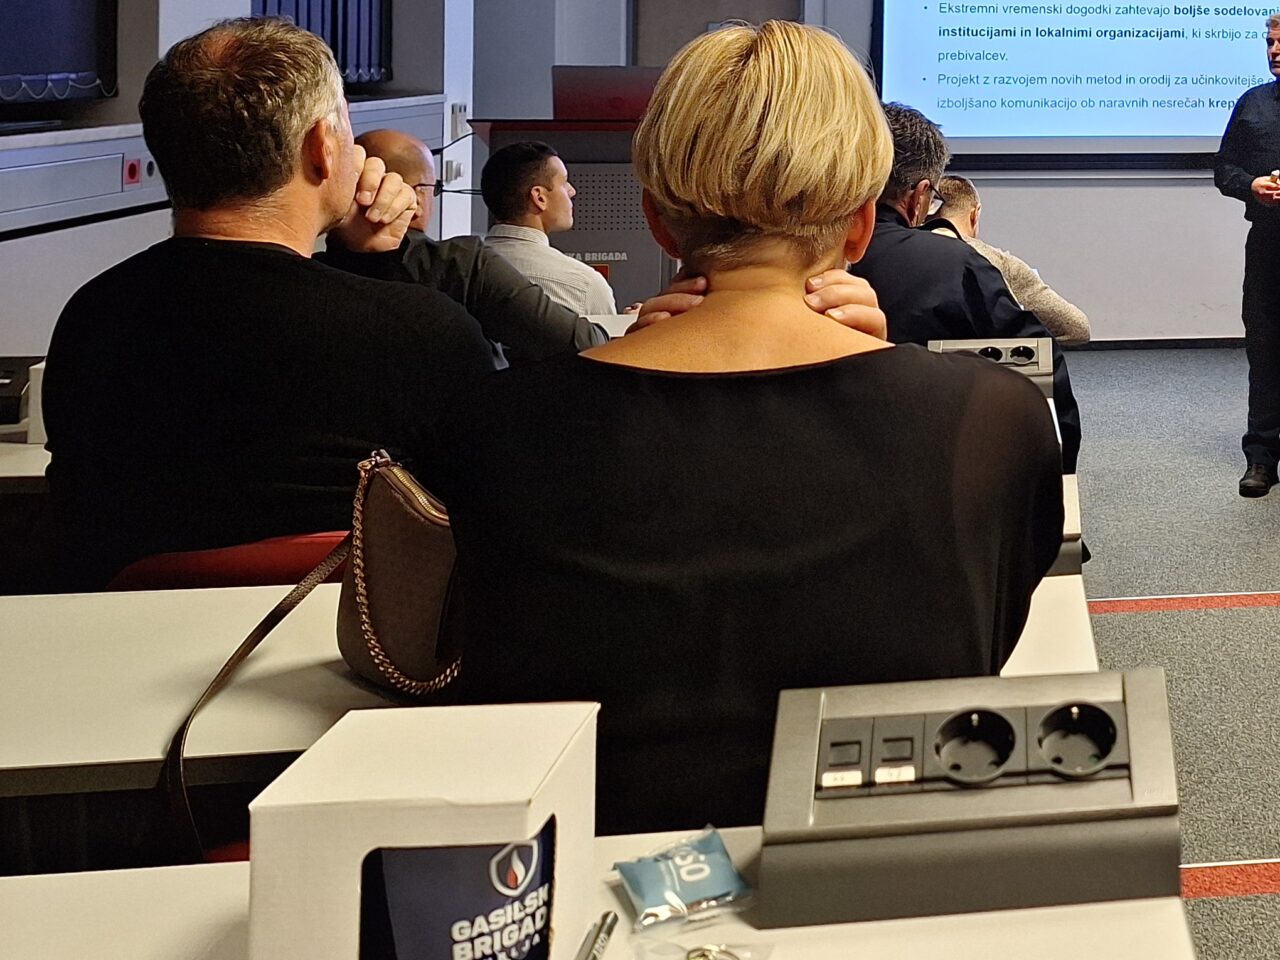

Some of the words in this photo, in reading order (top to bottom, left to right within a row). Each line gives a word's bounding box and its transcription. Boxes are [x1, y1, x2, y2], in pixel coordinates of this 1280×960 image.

[939, 3, 998, 14] Ekstremni
[1002, 3, 1062, 14] vremenski
[1066, 4, 1112, 17] dogodki
[1115, 5, 1170, 18] zahtevajo
[1174, 5, 1210, 17] boljše
[938, 26, 1016, 39] institucijami
[1021, 27, 1031, 38] in
[1035, 27, 1092, 38] lokalnimi
[1096, 28, 1188, 41] organizacijami,
[1192, 28, 1201, 39] ki
[1205, 28, 1241, 40] skrbijo
[1245, 31, 1258, 39] za
[938, 50, 1008, 62] prebivalcev.
[938, 74, 980, 87] Projekt
[983, 76, 989, 84] z
[993, 75, 1047, 87] razvojem
[1051, 74, 1082, 85] novih
[1086, 74, 1121, 85] metod
[1126, 74, 1135, 85] in
[1139, 75, 1170, 88] orodij
[1175, 76, 1187, 85] za
[1191, 75, 1264, 87] učinkovitejše
[937, 98, 997, 110] izboljšano
[1000, 97, 1077, 111] komunikacijo
[1081, 98, 1095, 108] ob
[1100, 98, 1148, 108] naravnih
[1152, 99, 1204, 109] nesrečah
[585, 252, 628, 261] BRIGADA
